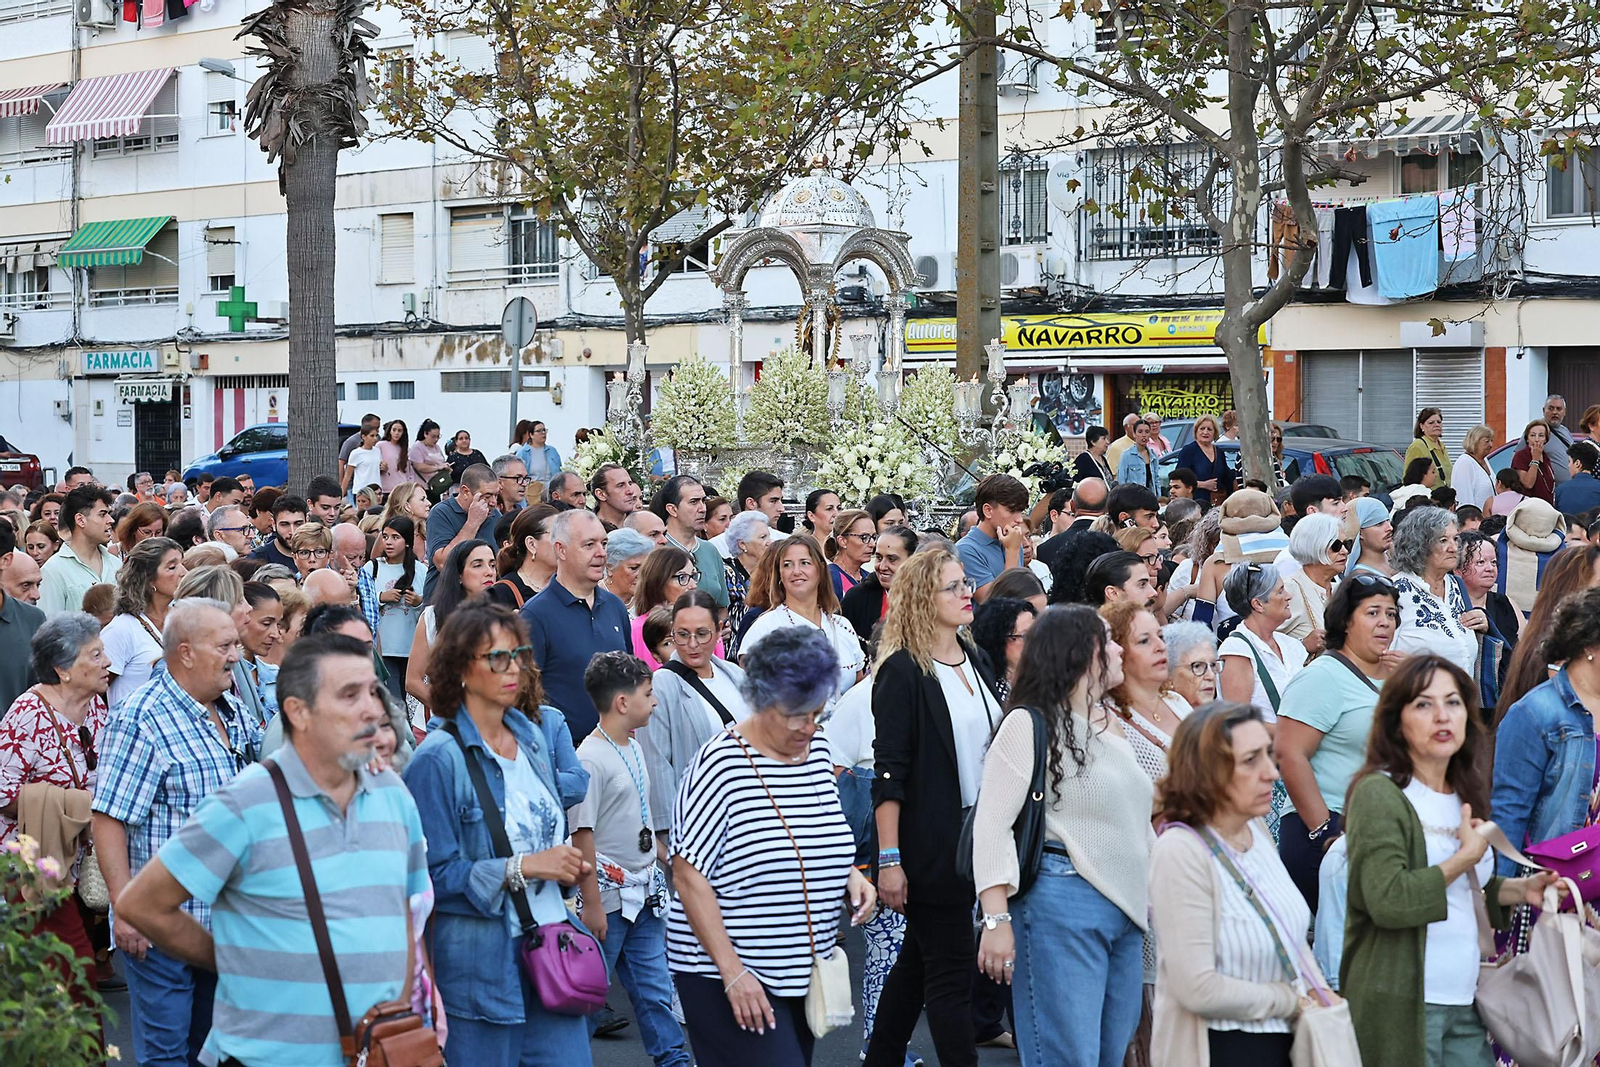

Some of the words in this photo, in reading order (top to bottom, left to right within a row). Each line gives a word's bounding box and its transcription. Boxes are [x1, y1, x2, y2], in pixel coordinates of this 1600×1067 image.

[1017, 326, 1142, 347] NAVARRO
[86, 351, 153, 370] FARMACIA
[119, 385, 168, 397] FARMACIA
[1140, 394, 1219, 408] NAVARRO
